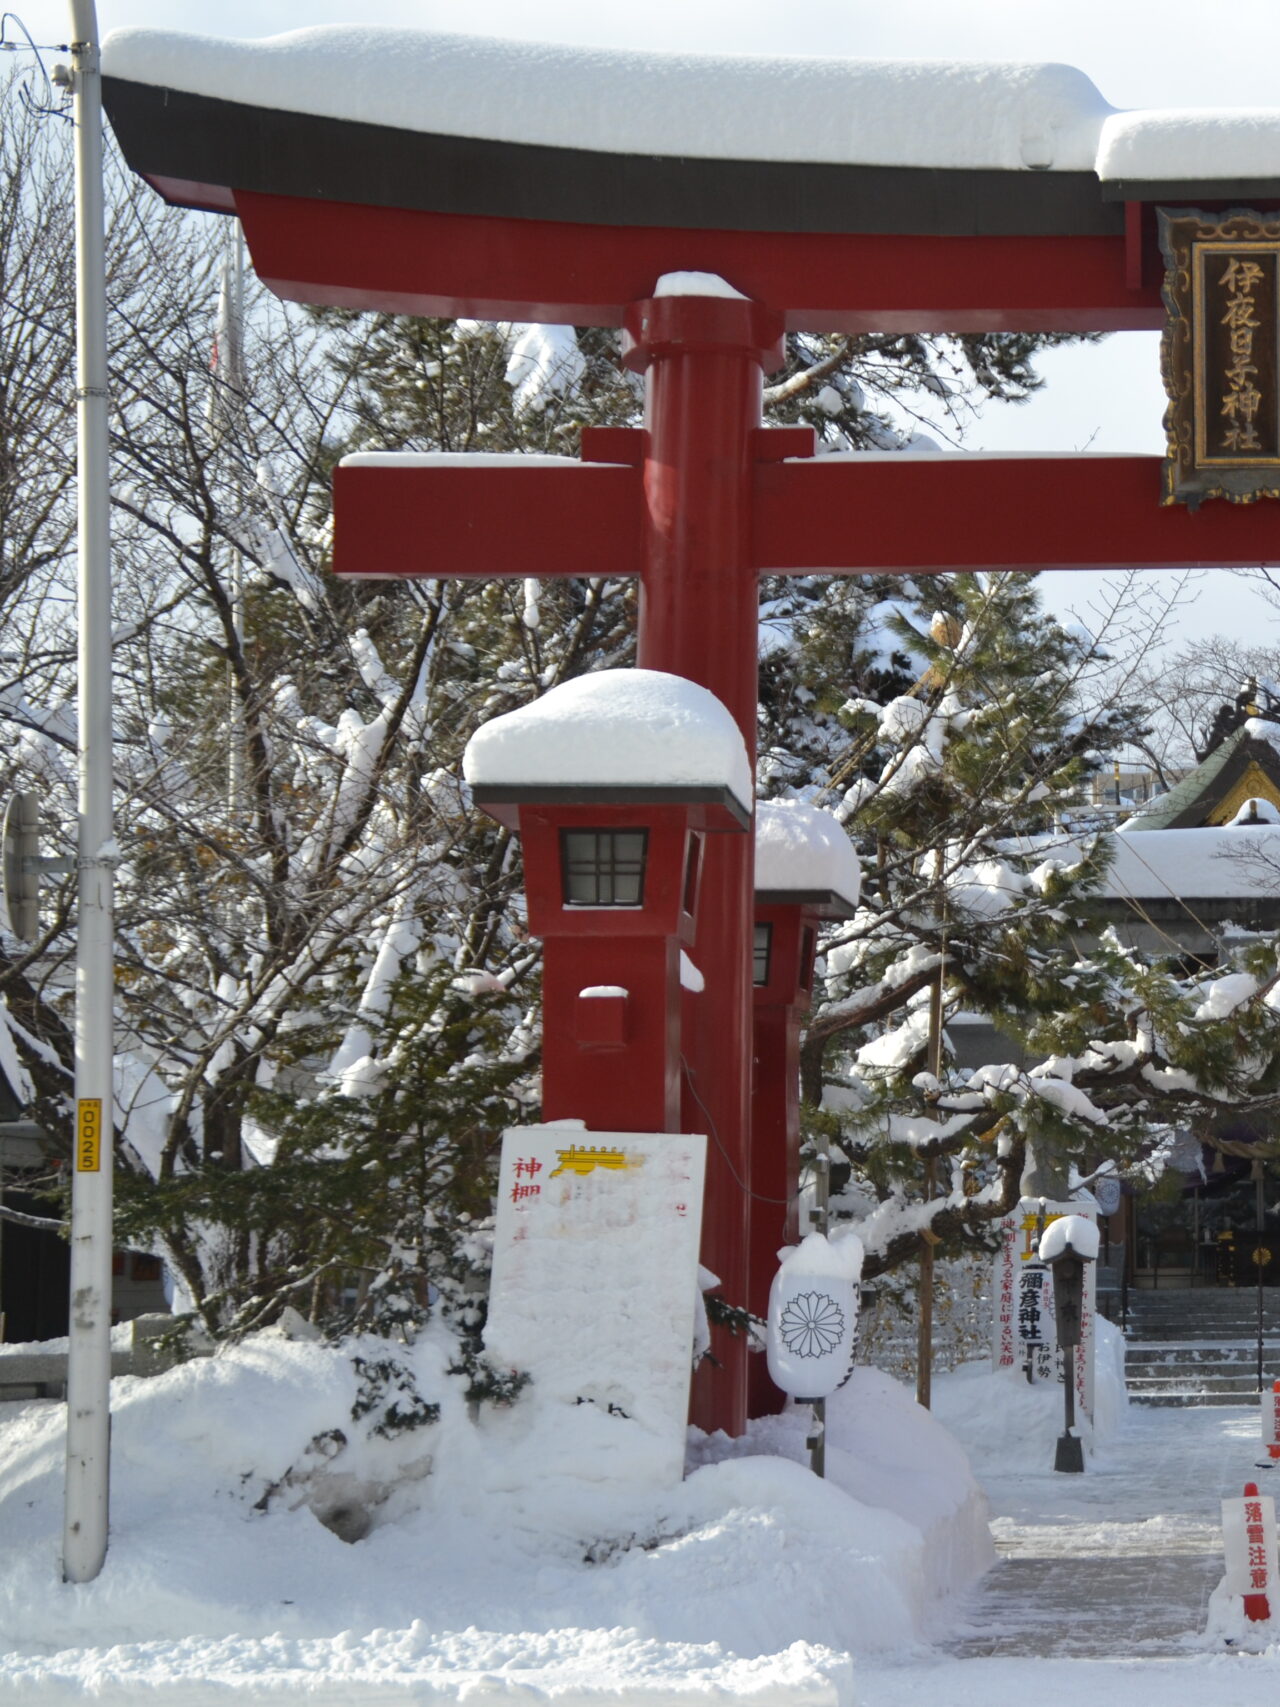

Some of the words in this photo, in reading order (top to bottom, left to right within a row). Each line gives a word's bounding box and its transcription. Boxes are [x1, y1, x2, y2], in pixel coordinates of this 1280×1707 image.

[1218, 258, 1264, 449] 伊夜日子神社
[83, 1111, 94, 1168] 0025
[1018, 1272, 1042, 1340] 彌彦神社
[1244, 1502, 1267, 1588] 落雪注意
